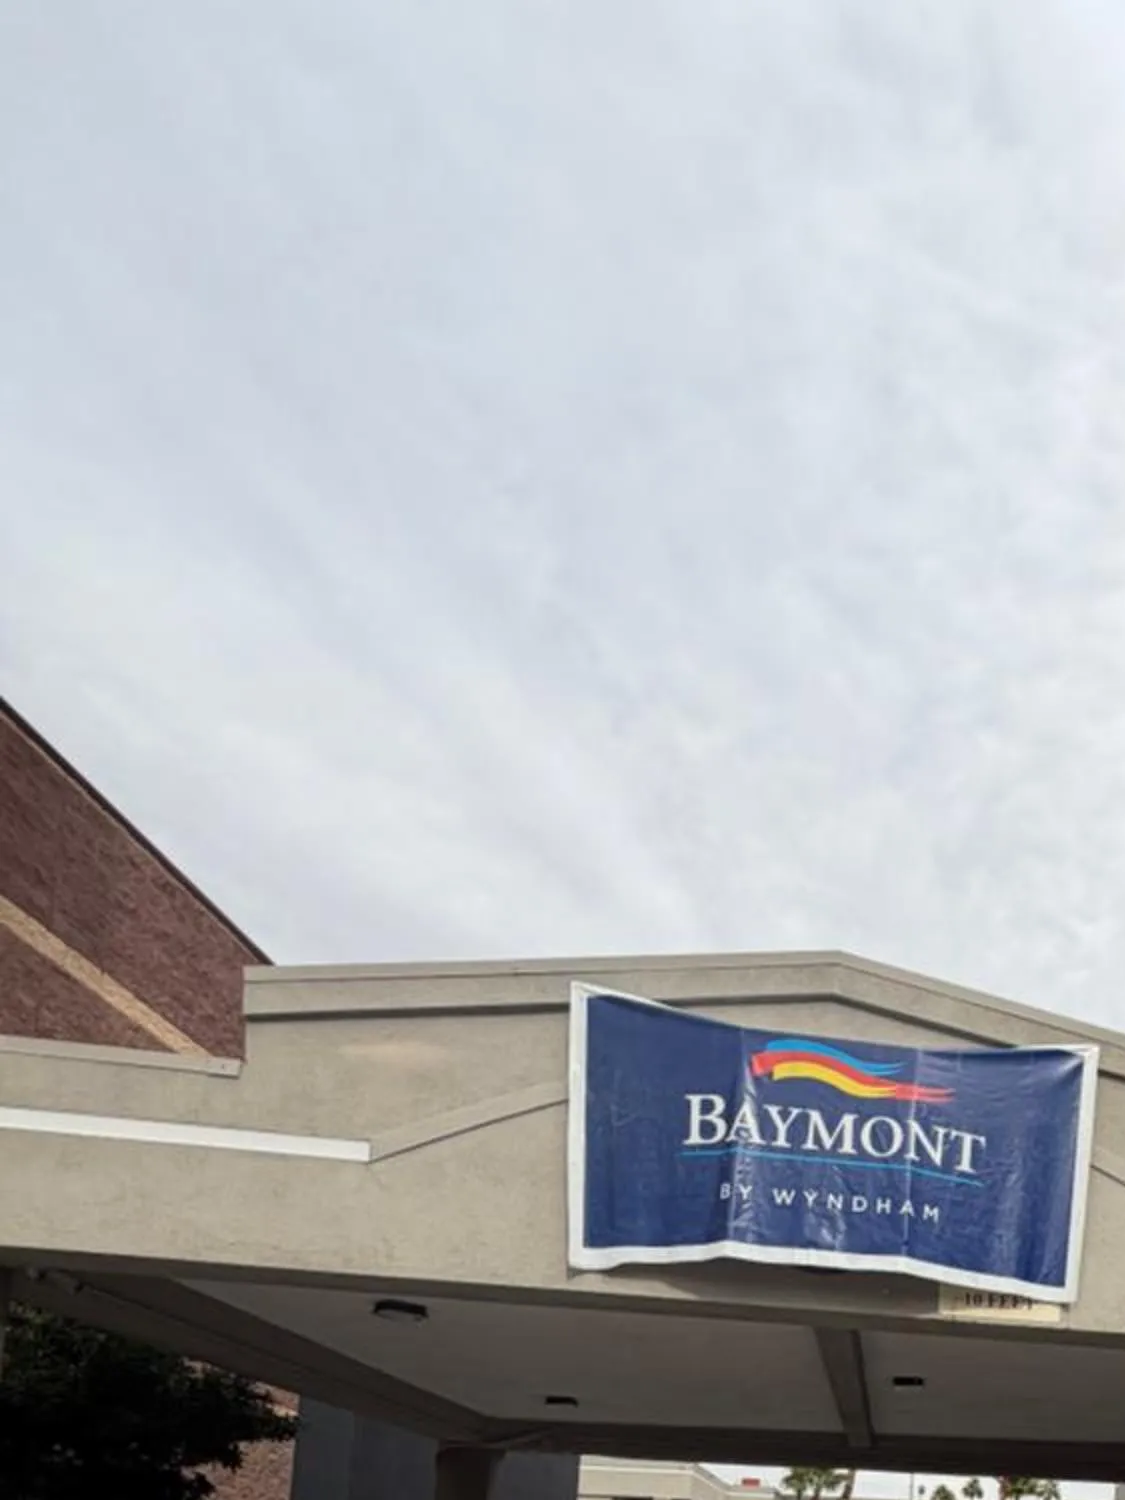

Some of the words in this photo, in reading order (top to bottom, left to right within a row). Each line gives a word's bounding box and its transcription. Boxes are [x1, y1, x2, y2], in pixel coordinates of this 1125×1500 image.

[682, 1093, 988, 1174] BAYMONT
[719, 1182, 753, 1201] BY
[771, 1187, 941, 1222] WYNDHAM
